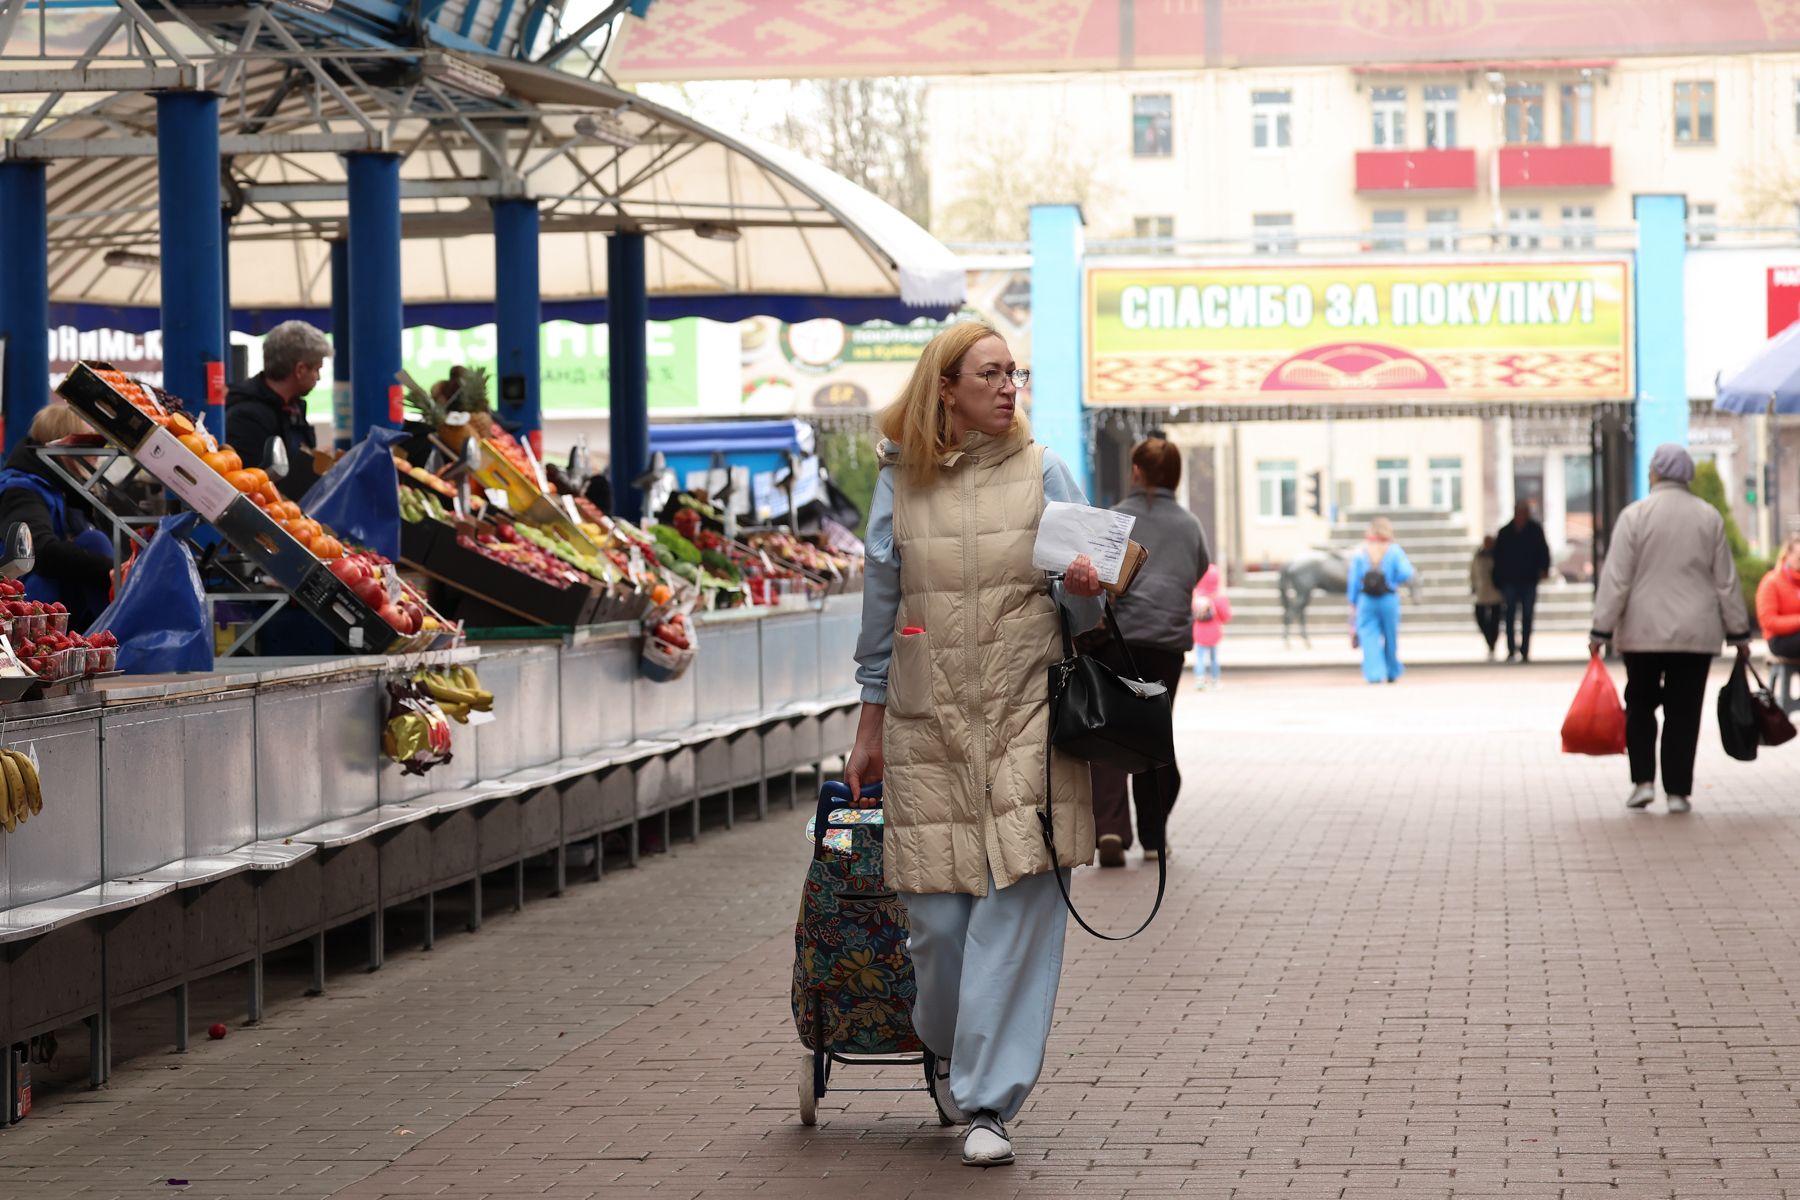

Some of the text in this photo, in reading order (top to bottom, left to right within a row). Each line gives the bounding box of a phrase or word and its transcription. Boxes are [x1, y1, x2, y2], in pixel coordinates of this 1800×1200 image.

[1120, 280, 1594, 329] СПАСИБО ЗА ПОКУПКУ!
